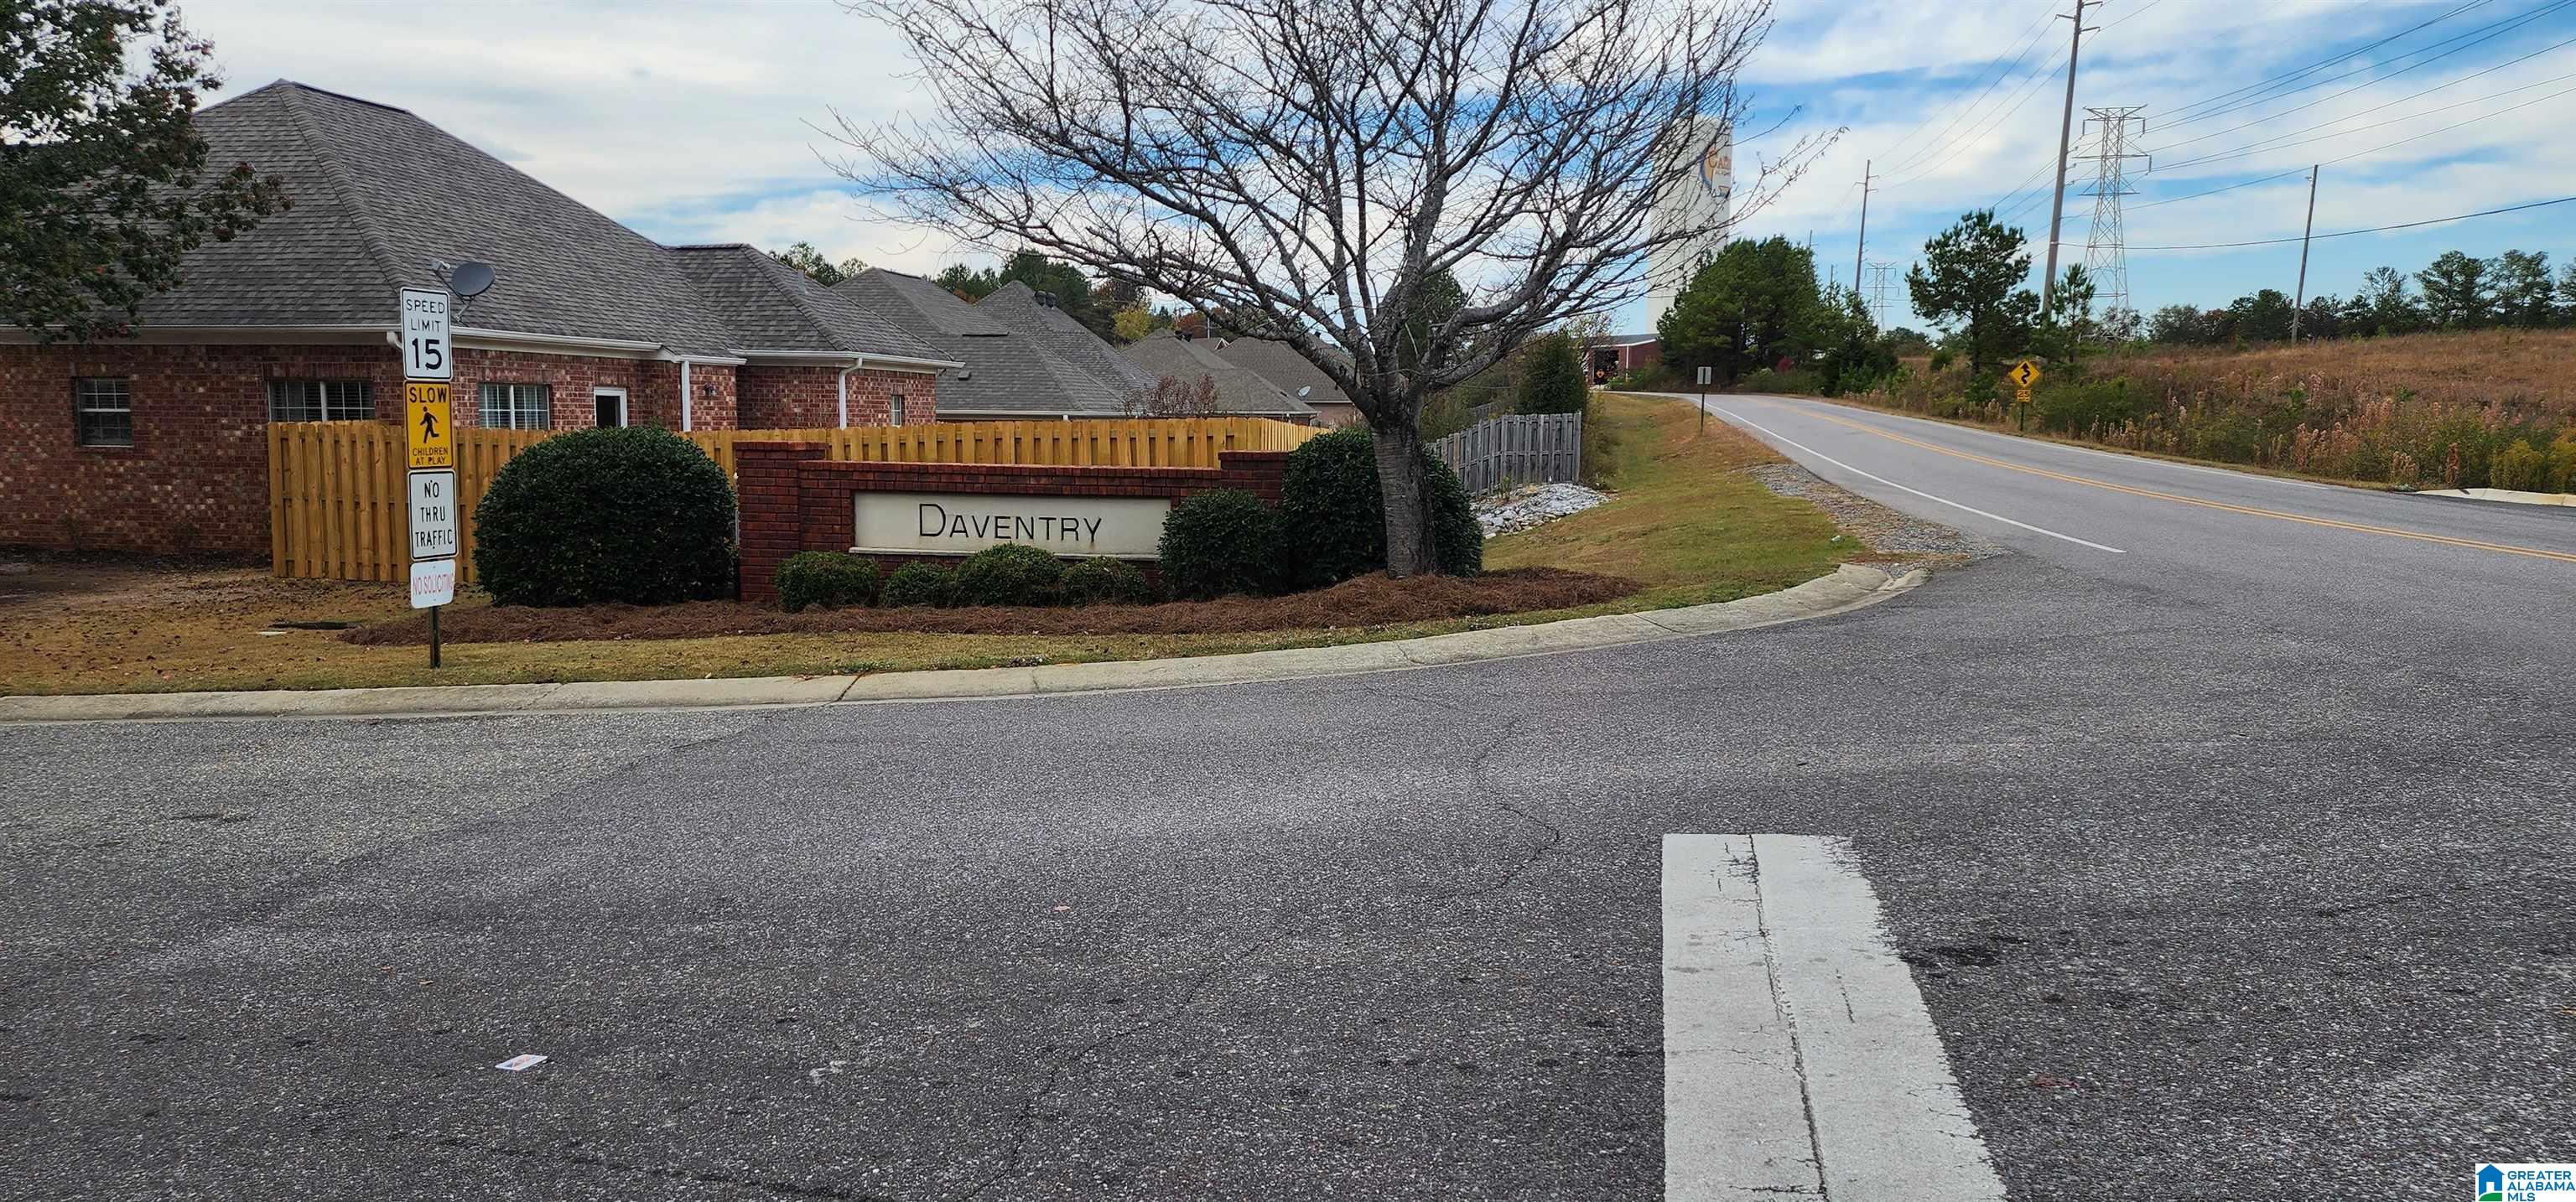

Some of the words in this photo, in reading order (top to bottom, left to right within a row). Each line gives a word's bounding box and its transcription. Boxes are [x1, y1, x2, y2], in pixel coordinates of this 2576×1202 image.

[406, 299, 445, 314] SPEED
[410, 319, 441, 332] LIMIT
[412, 337, 442, 370] 15
[409, 386, 447, 403] SLOW
[412, 447, 449, 456] CHILDREN
[416, 456, 424, 465] AT
[428, 456, 445, 465] PLAY
[424, 482, 439, 498] NO
[420, 505, 445, 523] THRU
[918, 503, 1103, 543] DAVENTRY
[415, 529, 453, 547] TRAFFIC
[413, 576, 423, 595] NO
